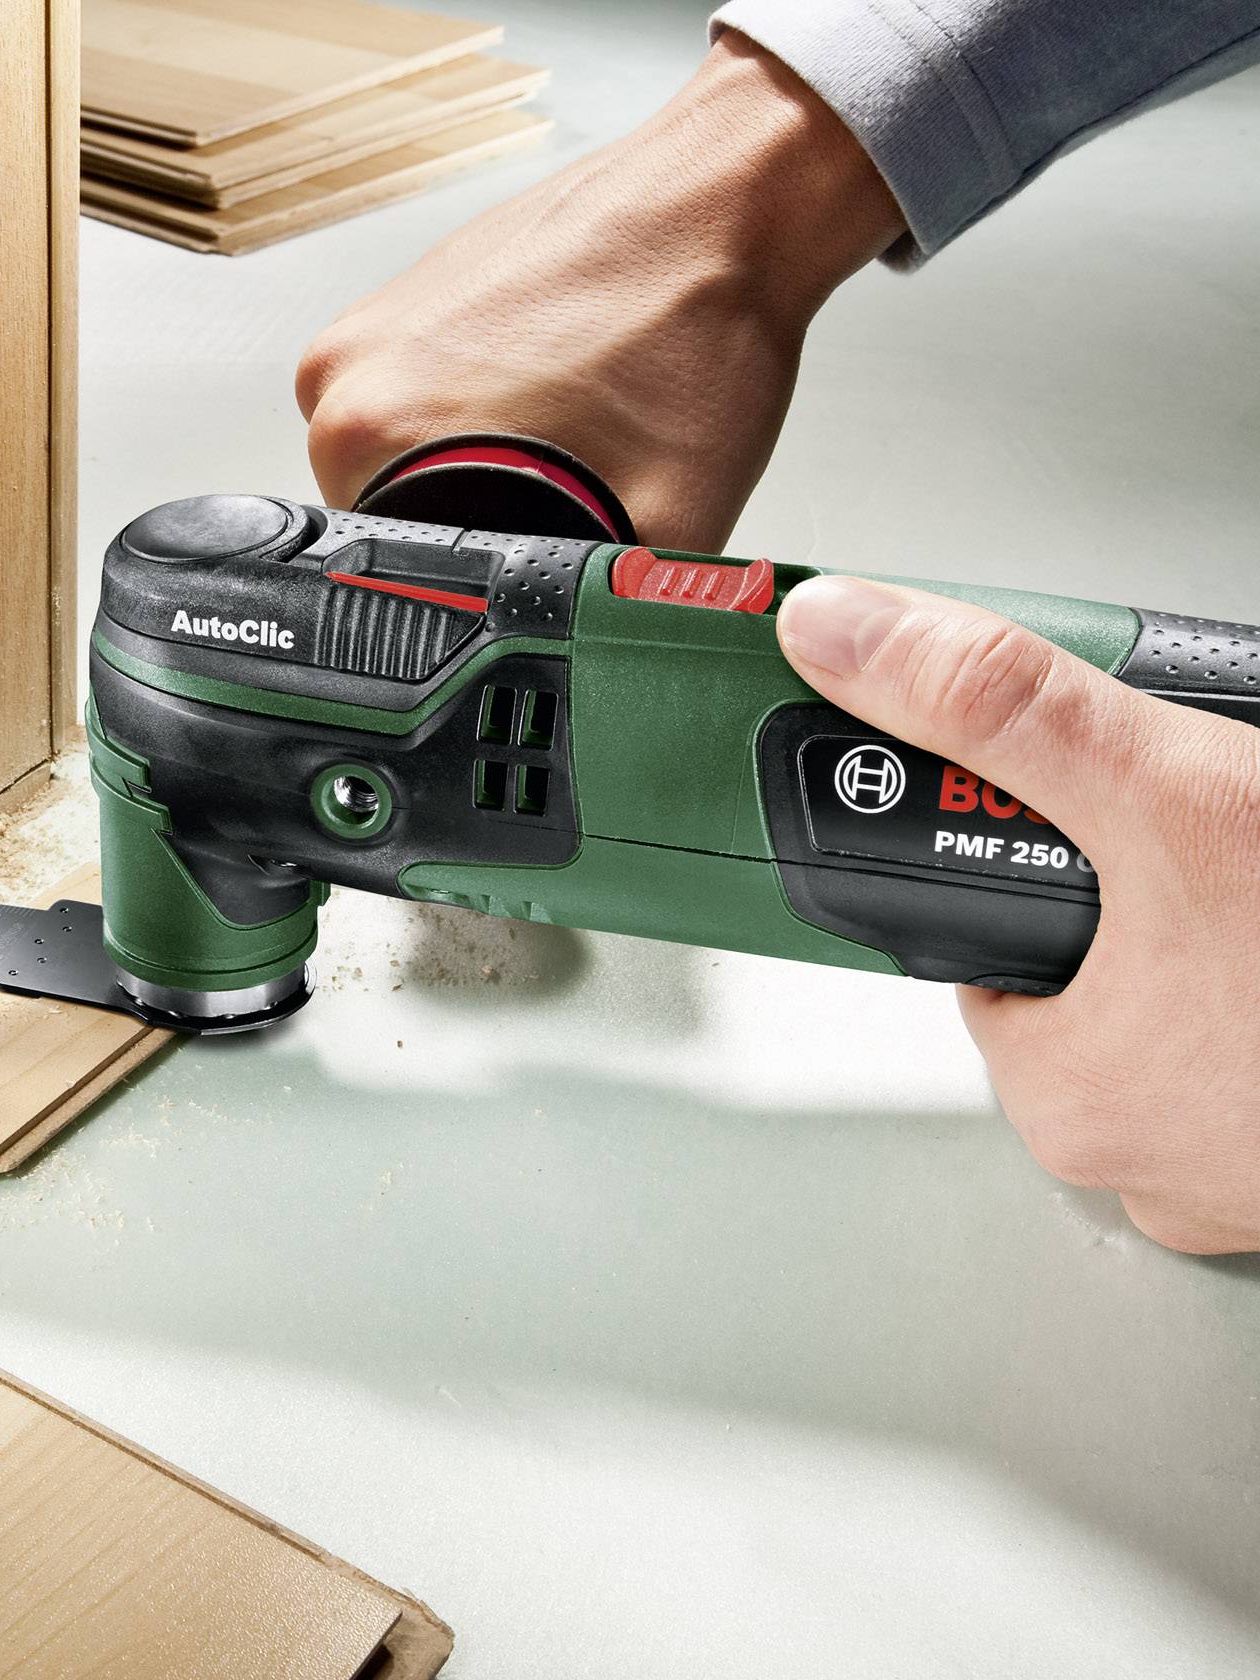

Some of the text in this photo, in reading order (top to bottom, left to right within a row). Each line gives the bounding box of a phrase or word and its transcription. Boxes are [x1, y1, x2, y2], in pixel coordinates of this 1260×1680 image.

[170, 609, 295, 650] AutoClic
[938, 764, 1052, 825] BO
[934, 830, 1005, 860] PMF
[1010, 841, 1070, 870] 250
